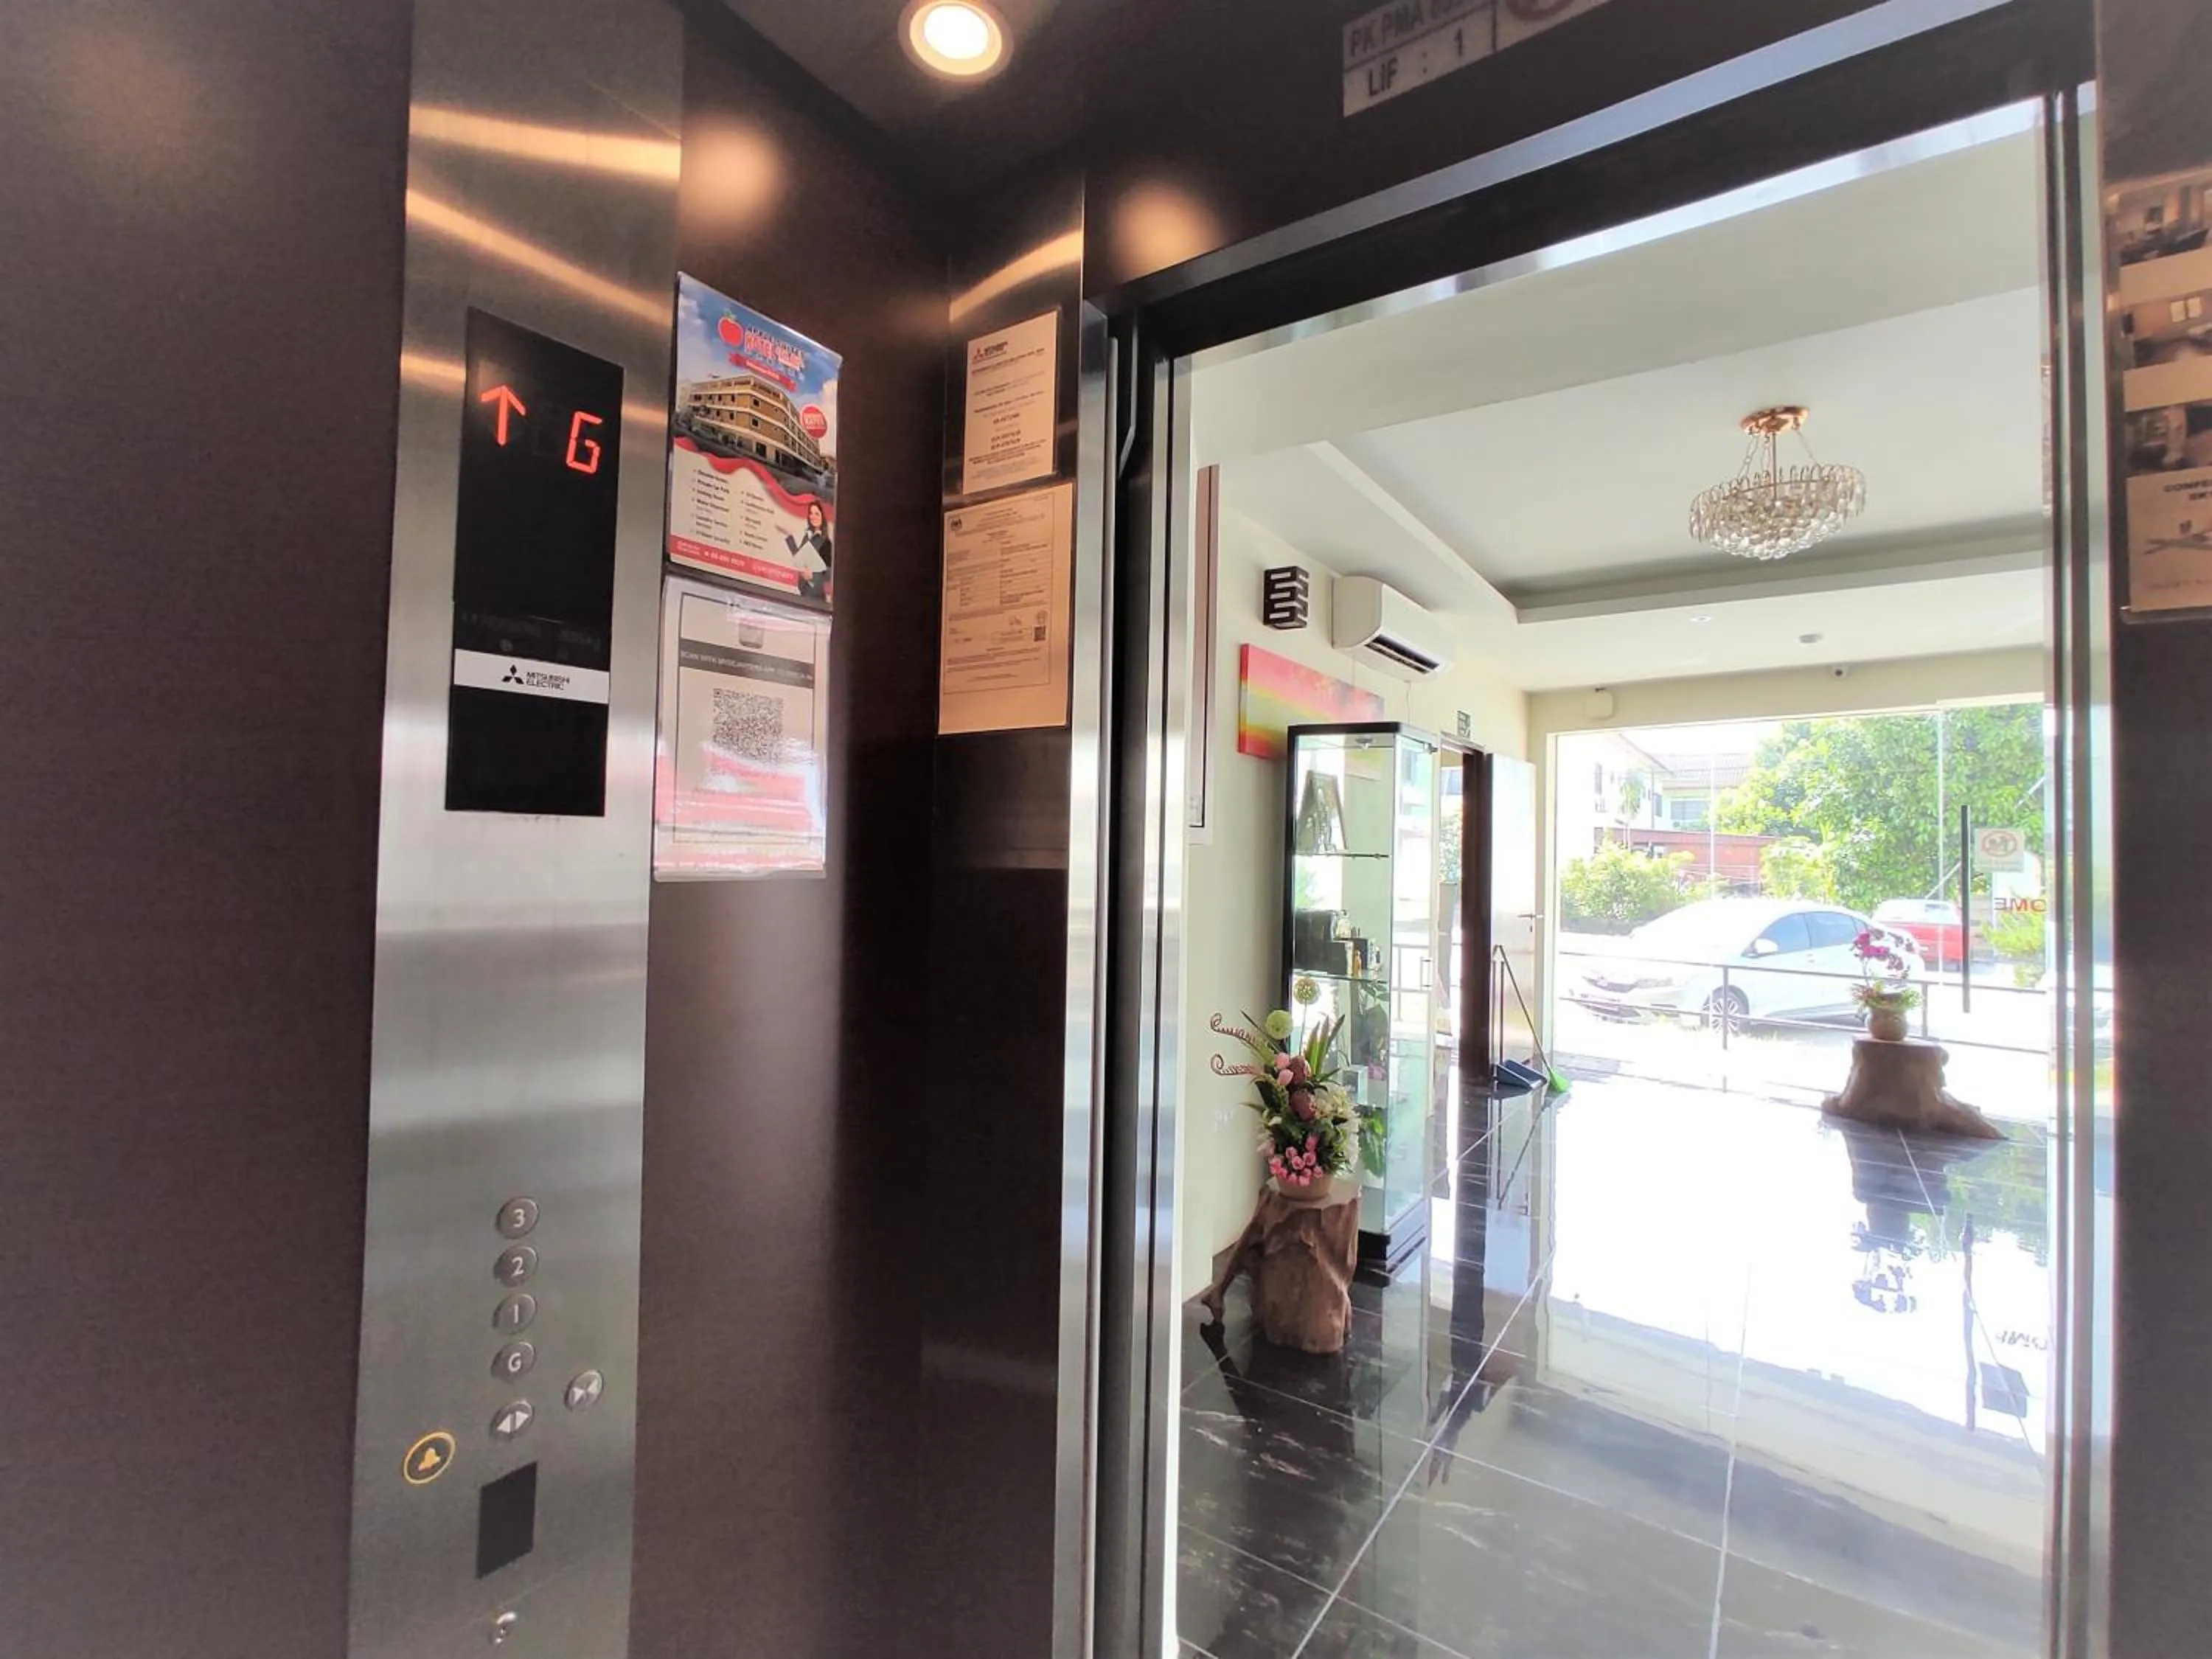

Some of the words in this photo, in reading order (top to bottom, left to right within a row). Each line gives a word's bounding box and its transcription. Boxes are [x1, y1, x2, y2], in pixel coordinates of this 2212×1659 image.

[1368, 55, 1399, 98] LIF
[1454, 27, 1464, 58] 1
[566, 410, 604, 474] G
[526, 672, 571, 684] MITSUBISHI
[526, 679, 565, 691] ELECTRIC
[512, 1208, 525, 1228] 3
[512, 1256, 525, 1278] 2
[508, 1352, 521, 1373] G
